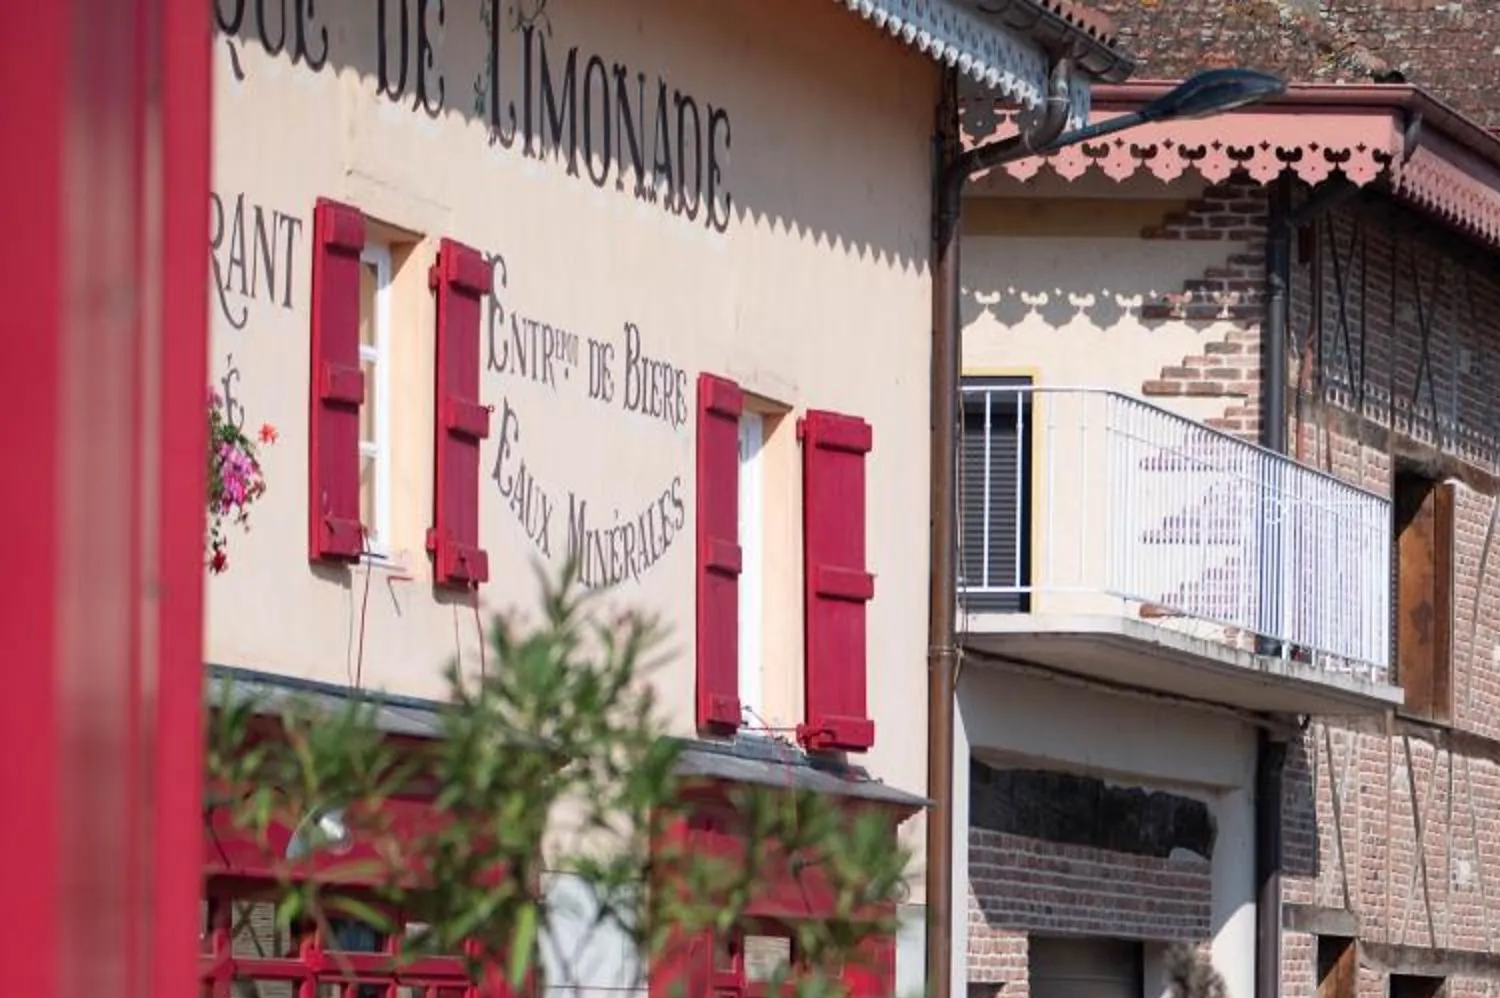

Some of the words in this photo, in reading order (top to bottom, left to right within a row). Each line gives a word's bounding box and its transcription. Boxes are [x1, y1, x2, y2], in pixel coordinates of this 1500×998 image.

[487, 0, 732, 234] LIMONADE
[587, 337, 616, 404] DE
[492, 396, 553, 560] EAUX
[566, 475, 685, 590] MINÉRALES
